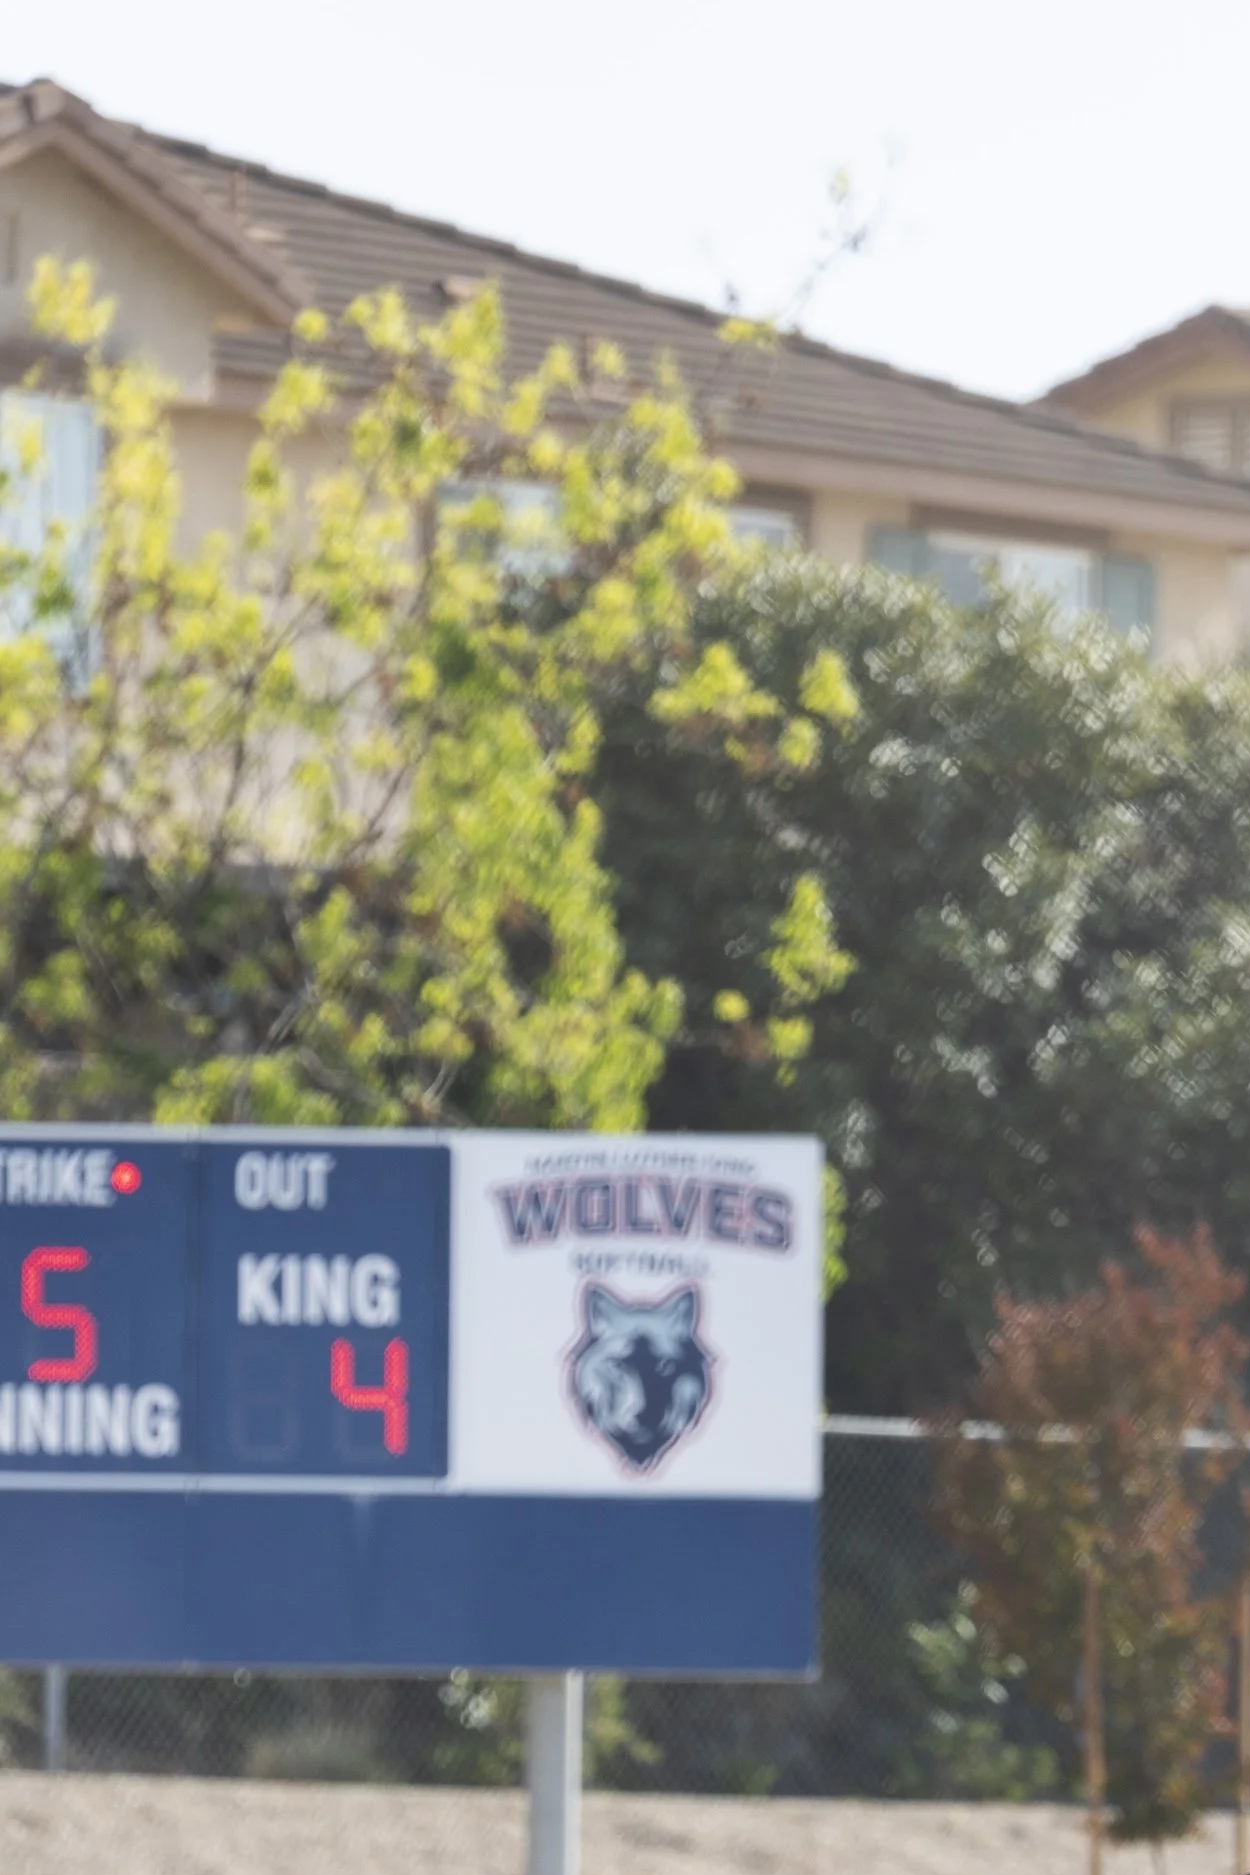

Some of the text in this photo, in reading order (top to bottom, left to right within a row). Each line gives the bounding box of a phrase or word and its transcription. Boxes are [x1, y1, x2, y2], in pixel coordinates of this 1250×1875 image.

[0, 1147, 116, 1207] RIKE
[234, 1150, 335, 1211] OUT
[492, 1173, 795, 1254] WOLVES
[21, 1246, 97, 1383] 5
[237, 1252, 401, 1329] KING
[330, 1337, 409, 1456] 4
